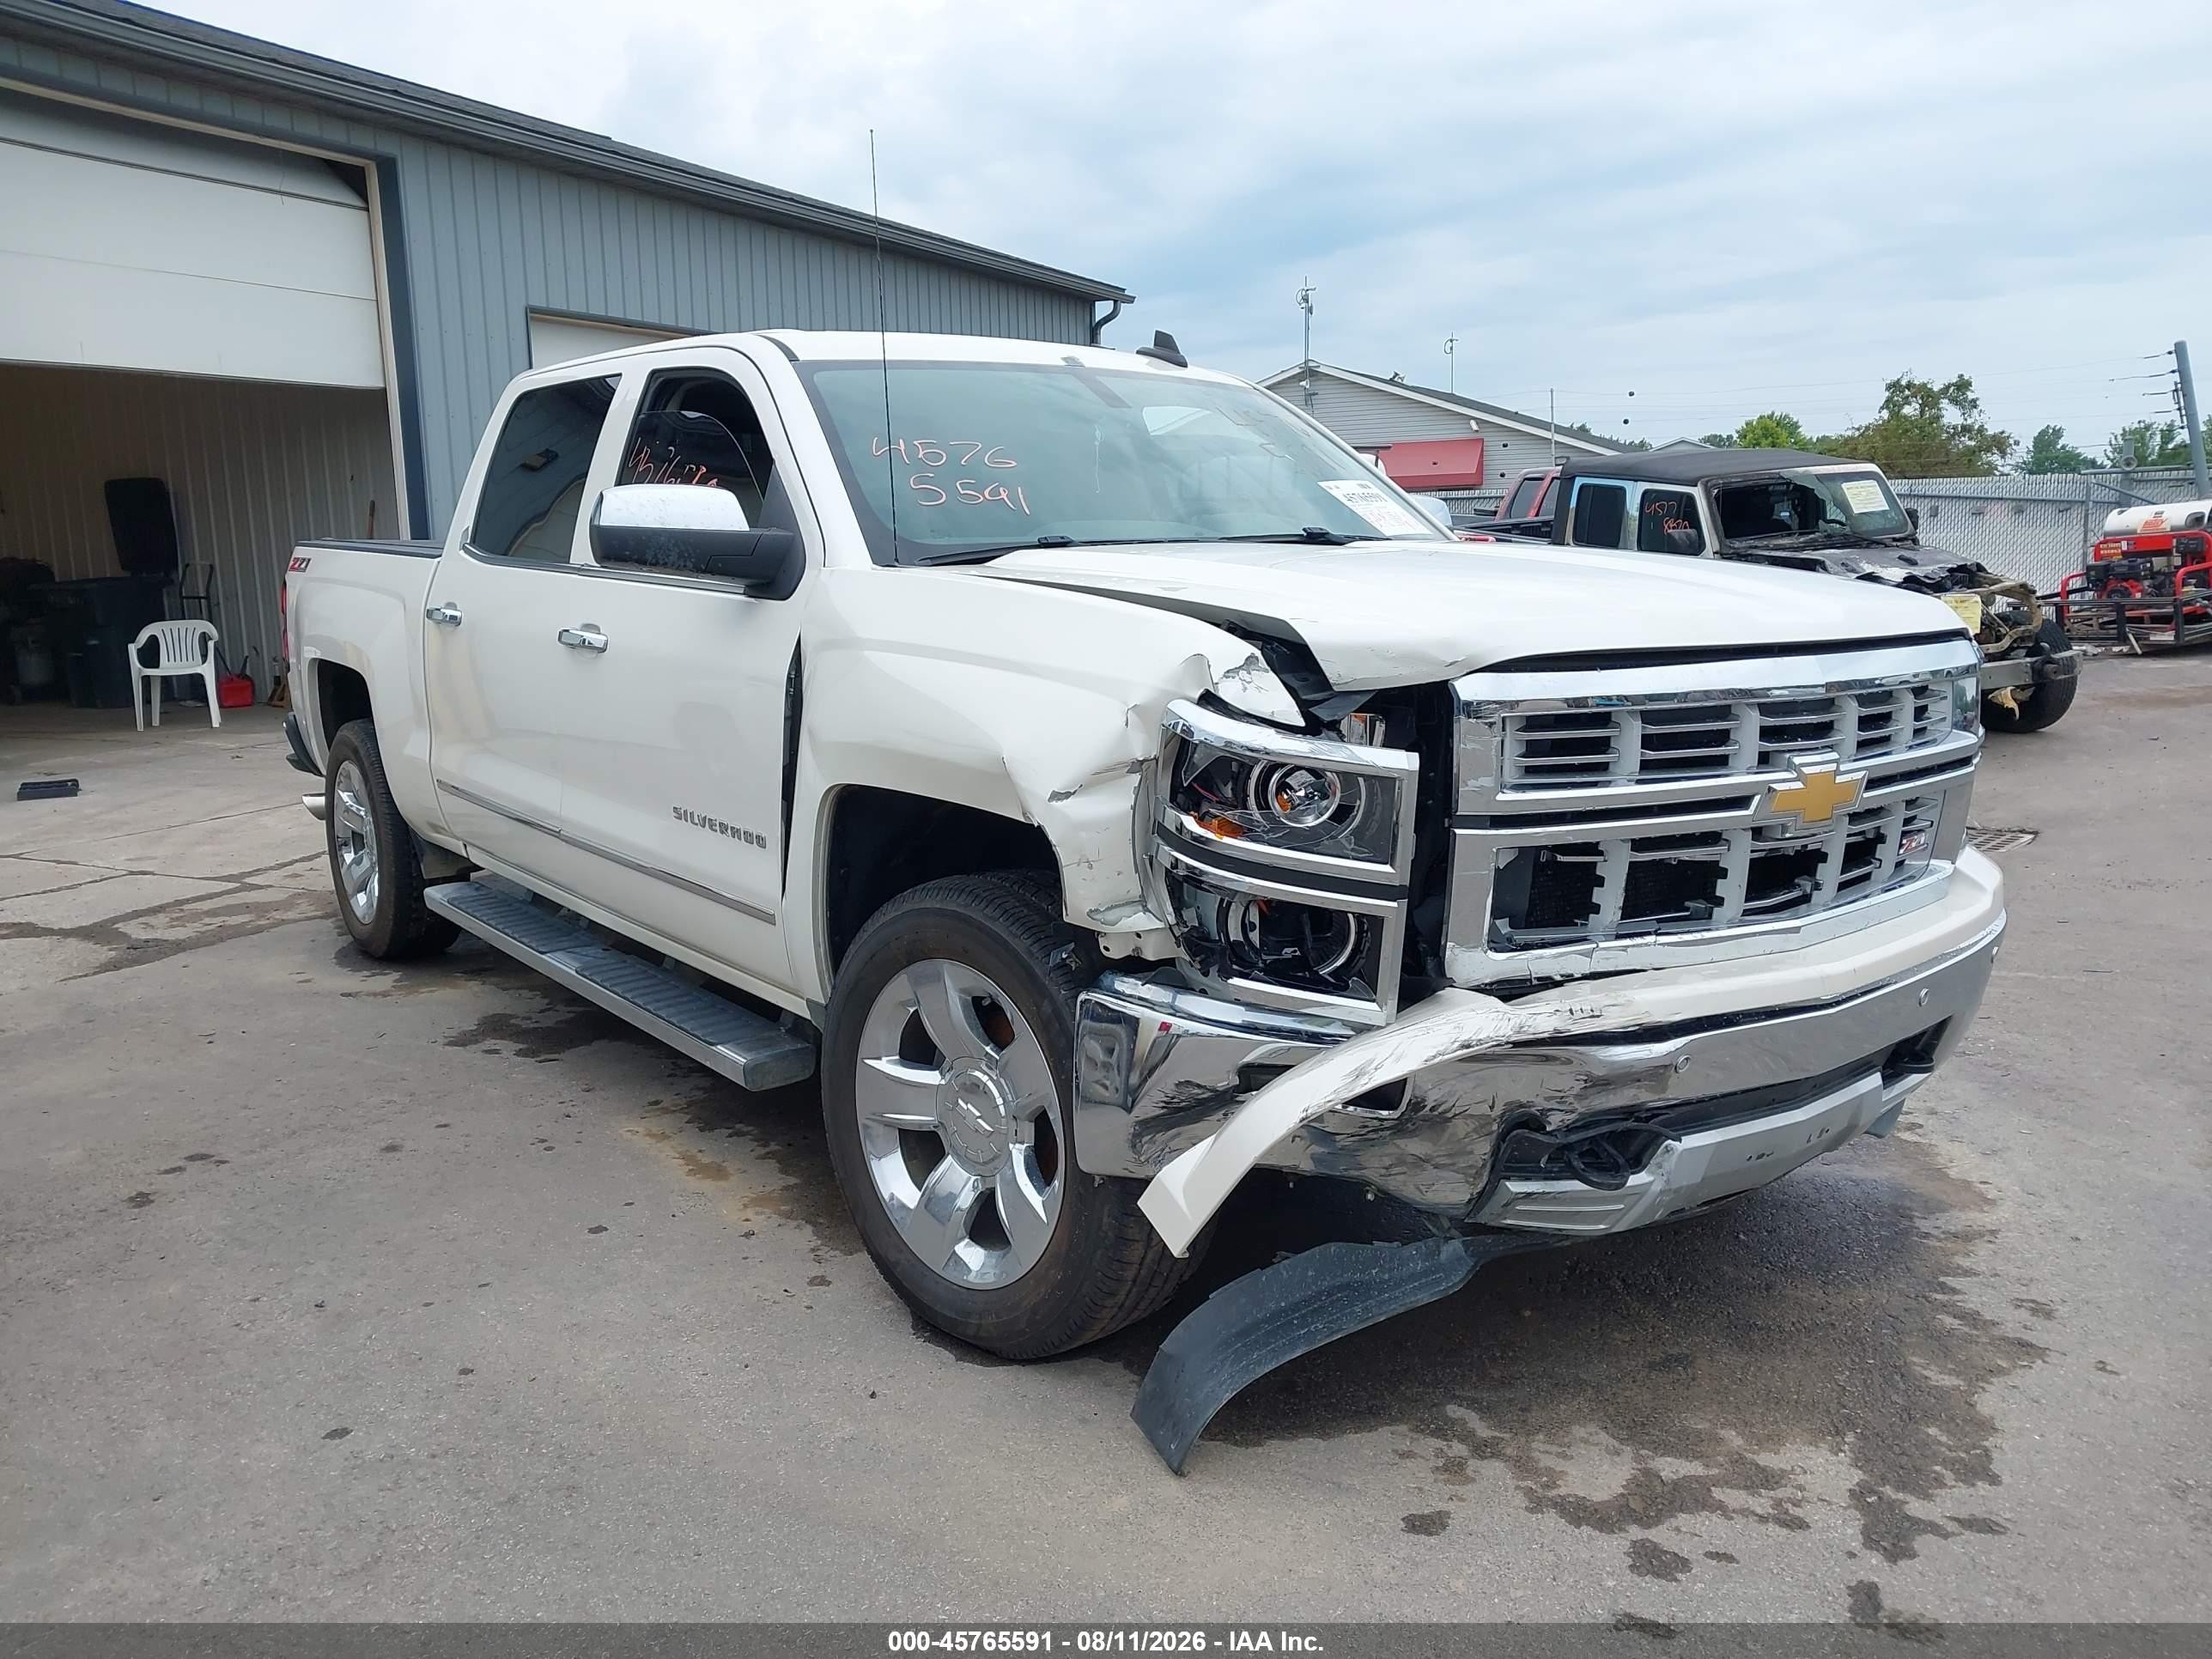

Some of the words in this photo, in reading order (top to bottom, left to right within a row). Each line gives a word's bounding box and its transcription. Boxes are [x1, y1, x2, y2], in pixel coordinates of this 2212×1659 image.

[872, 436, 1018, 467] 4576
[910, 473, 1030, 516] 5591
[672, 805, 767, 849] SILVERADO
